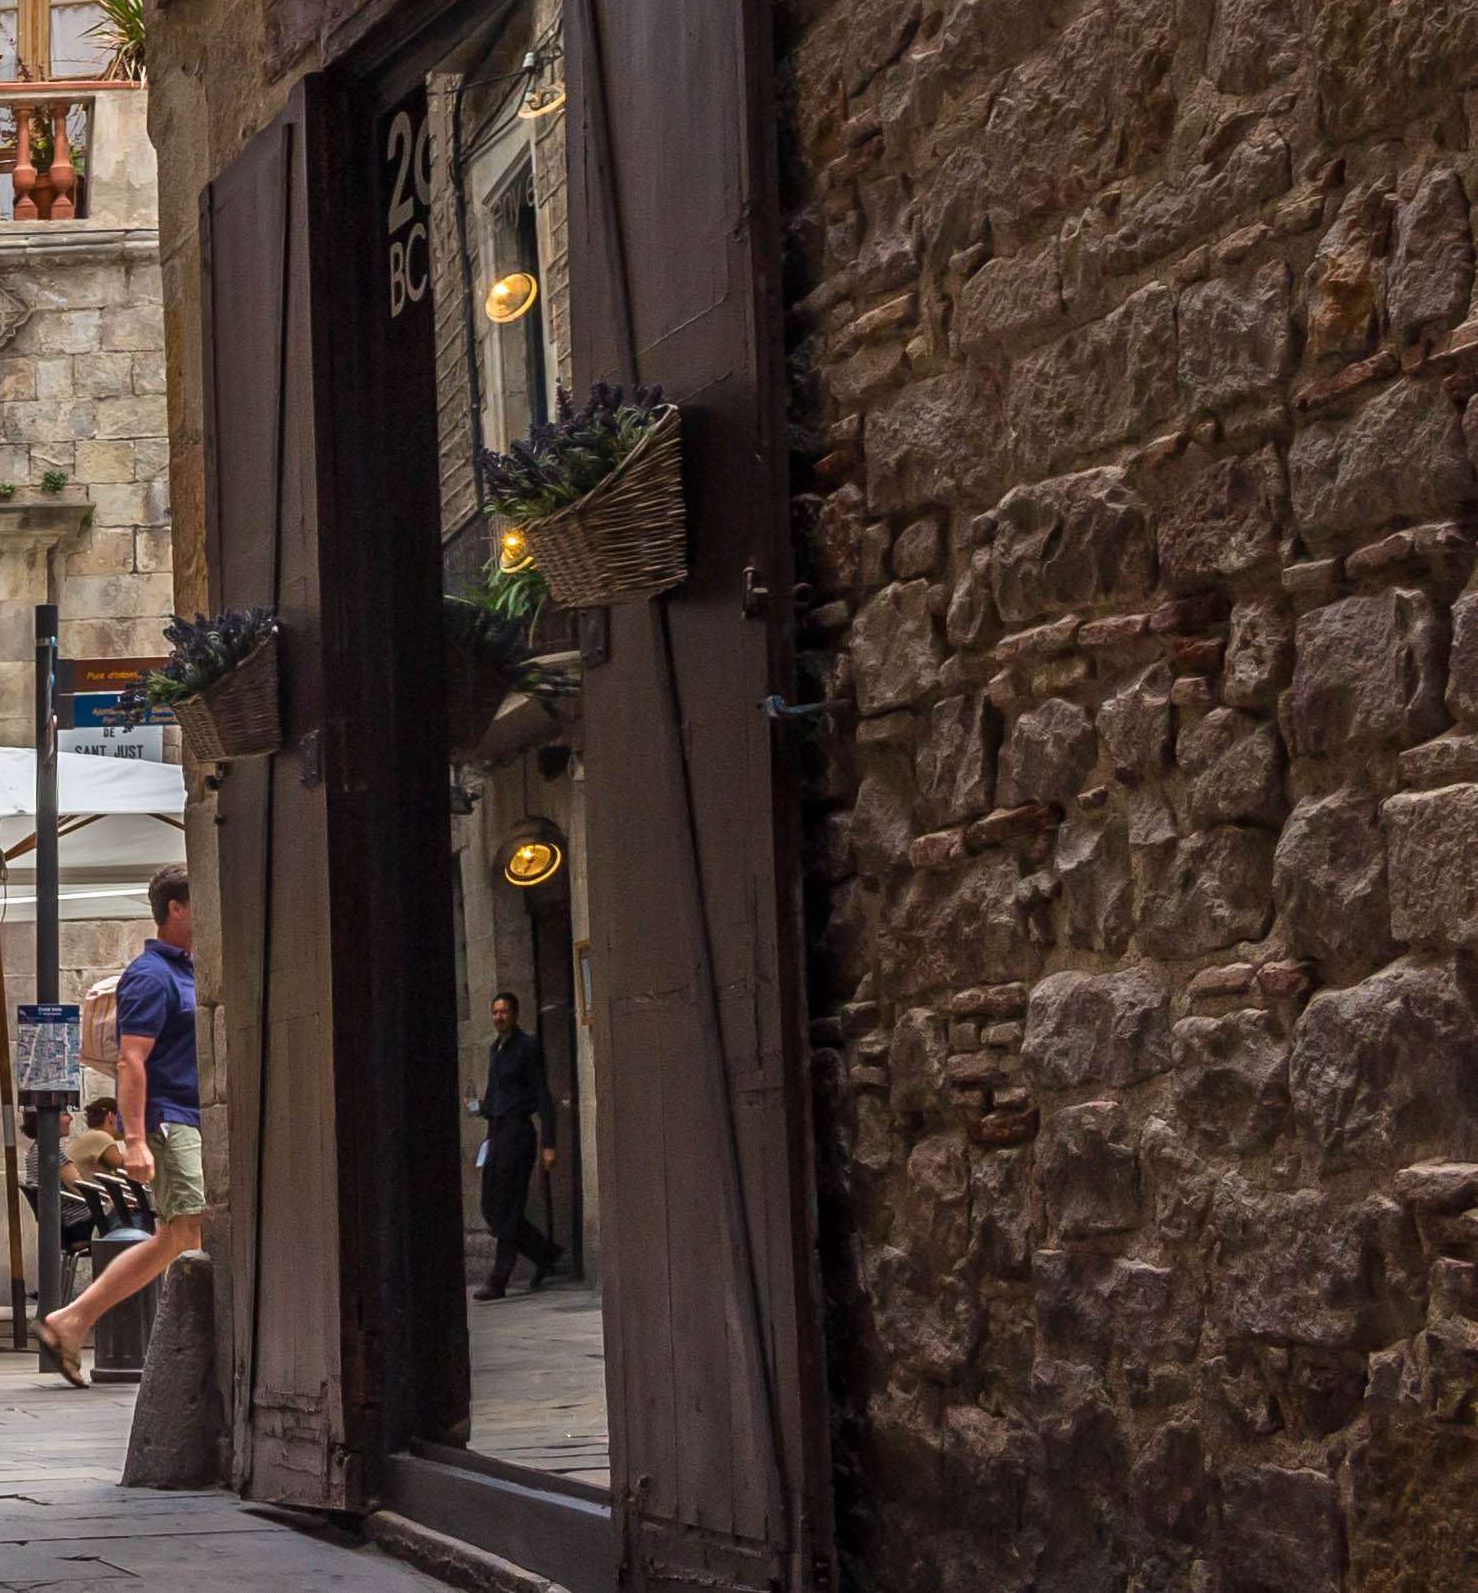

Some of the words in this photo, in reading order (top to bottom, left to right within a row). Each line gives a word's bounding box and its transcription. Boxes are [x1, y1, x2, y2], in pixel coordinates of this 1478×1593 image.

[390, 222, 428, 318] BC
[103, 727, 115, 737] DE
[75, 745, 107, 755] SANT
[114, 745, 144, 758] JUST
